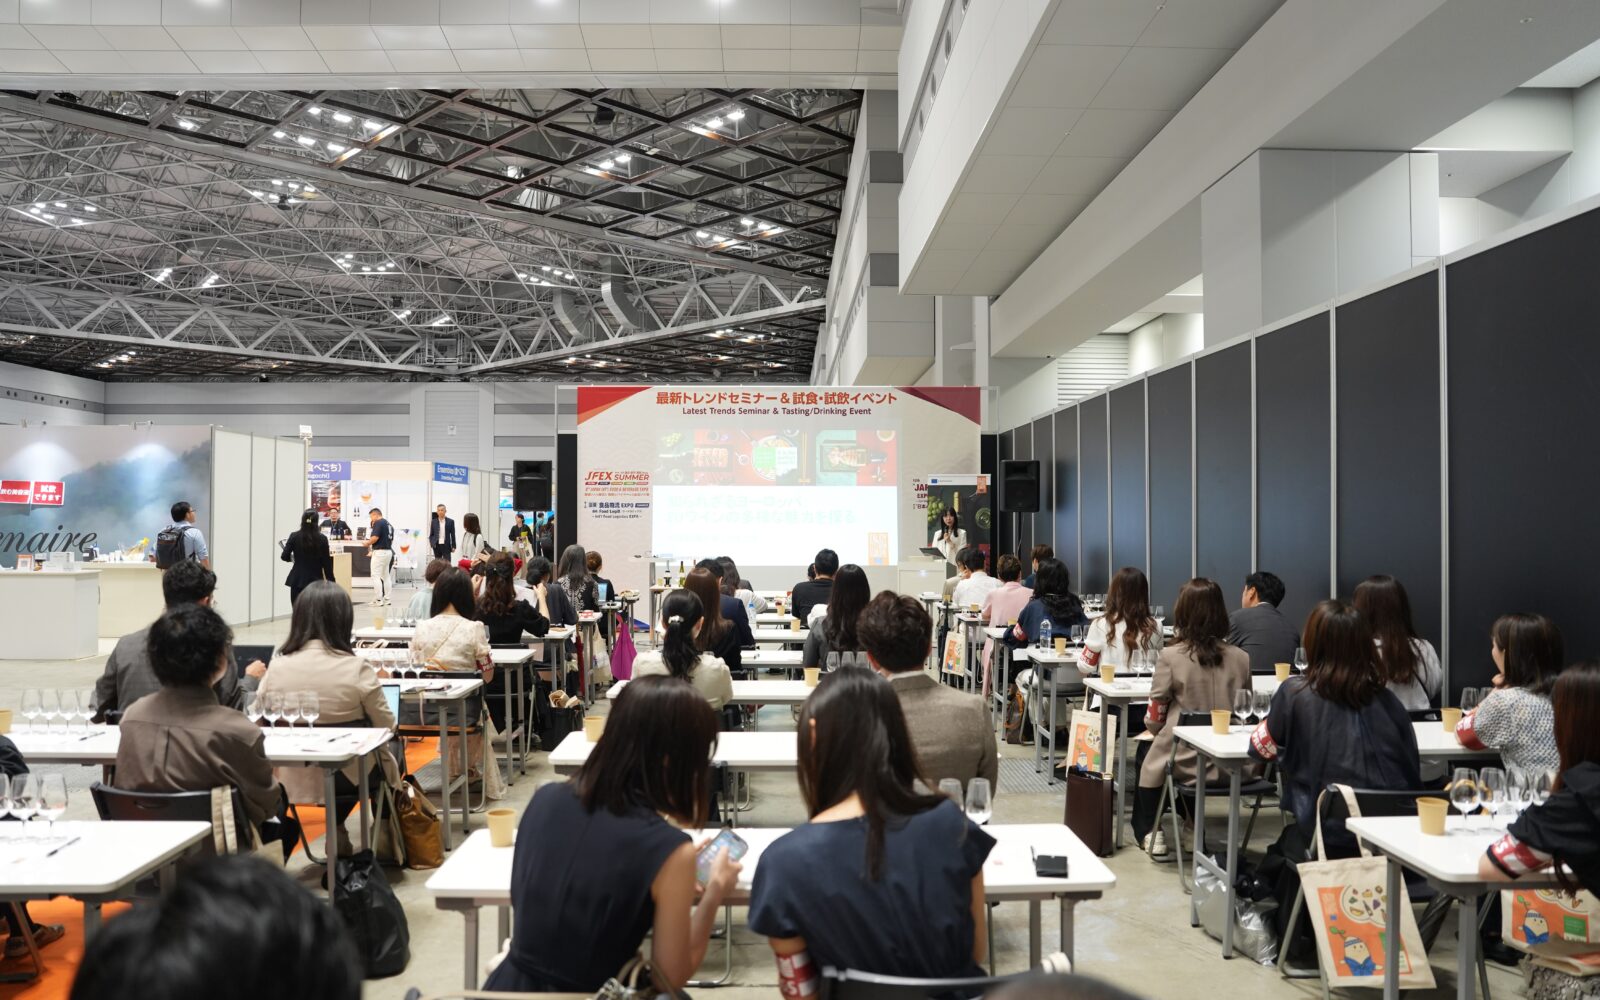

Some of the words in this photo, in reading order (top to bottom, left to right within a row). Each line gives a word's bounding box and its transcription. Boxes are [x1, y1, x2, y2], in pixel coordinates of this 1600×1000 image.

[682, 407, 707, 415] Latest
[710, 407, 736, 415] Trends
[738, 407, 770, 415] Seminar
[781, 407, 847, 416] Tasting/Drinking
[849, 407, 871, 415] Event
[584, 471, 613, 481] JFEX
[0, 524, 98, 554] naire
